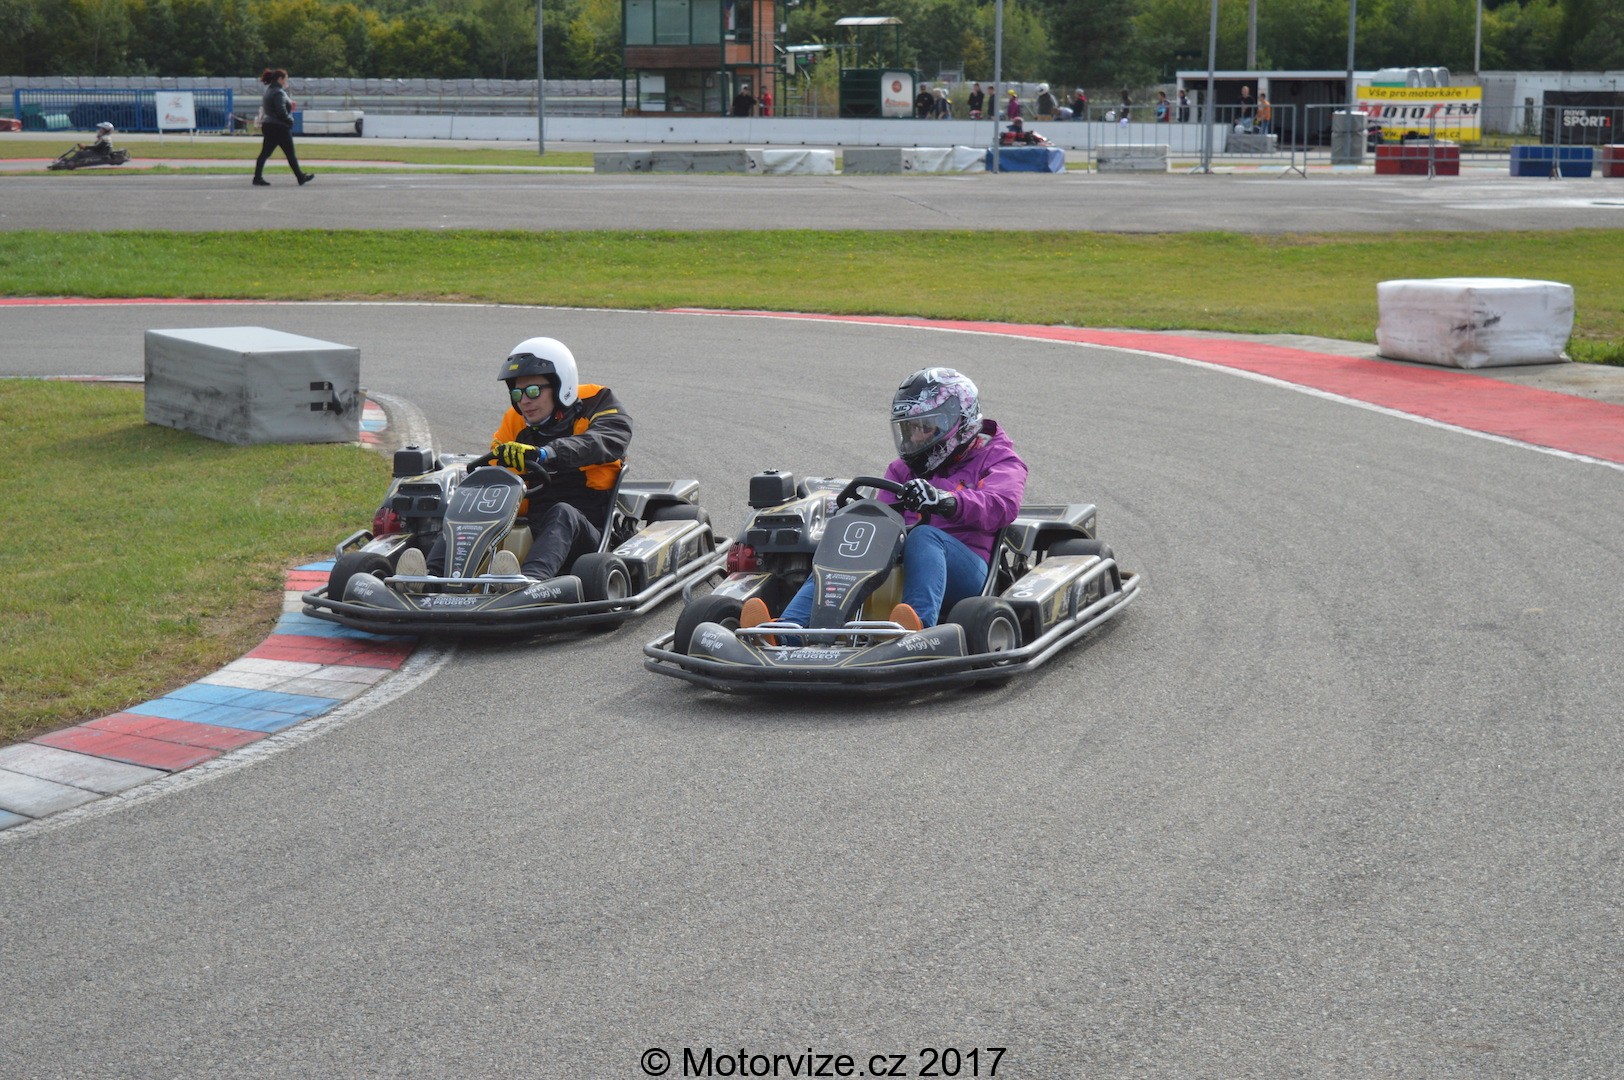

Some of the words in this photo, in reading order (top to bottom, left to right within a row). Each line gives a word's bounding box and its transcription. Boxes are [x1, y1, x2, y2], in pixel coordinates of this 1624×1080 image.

[1389, 90, 1406, 100] pro
[1563, 116, 1612, 127] SPORT1
[459, 484, 511, 514] 19
[838, 521, 876, 558] 9
